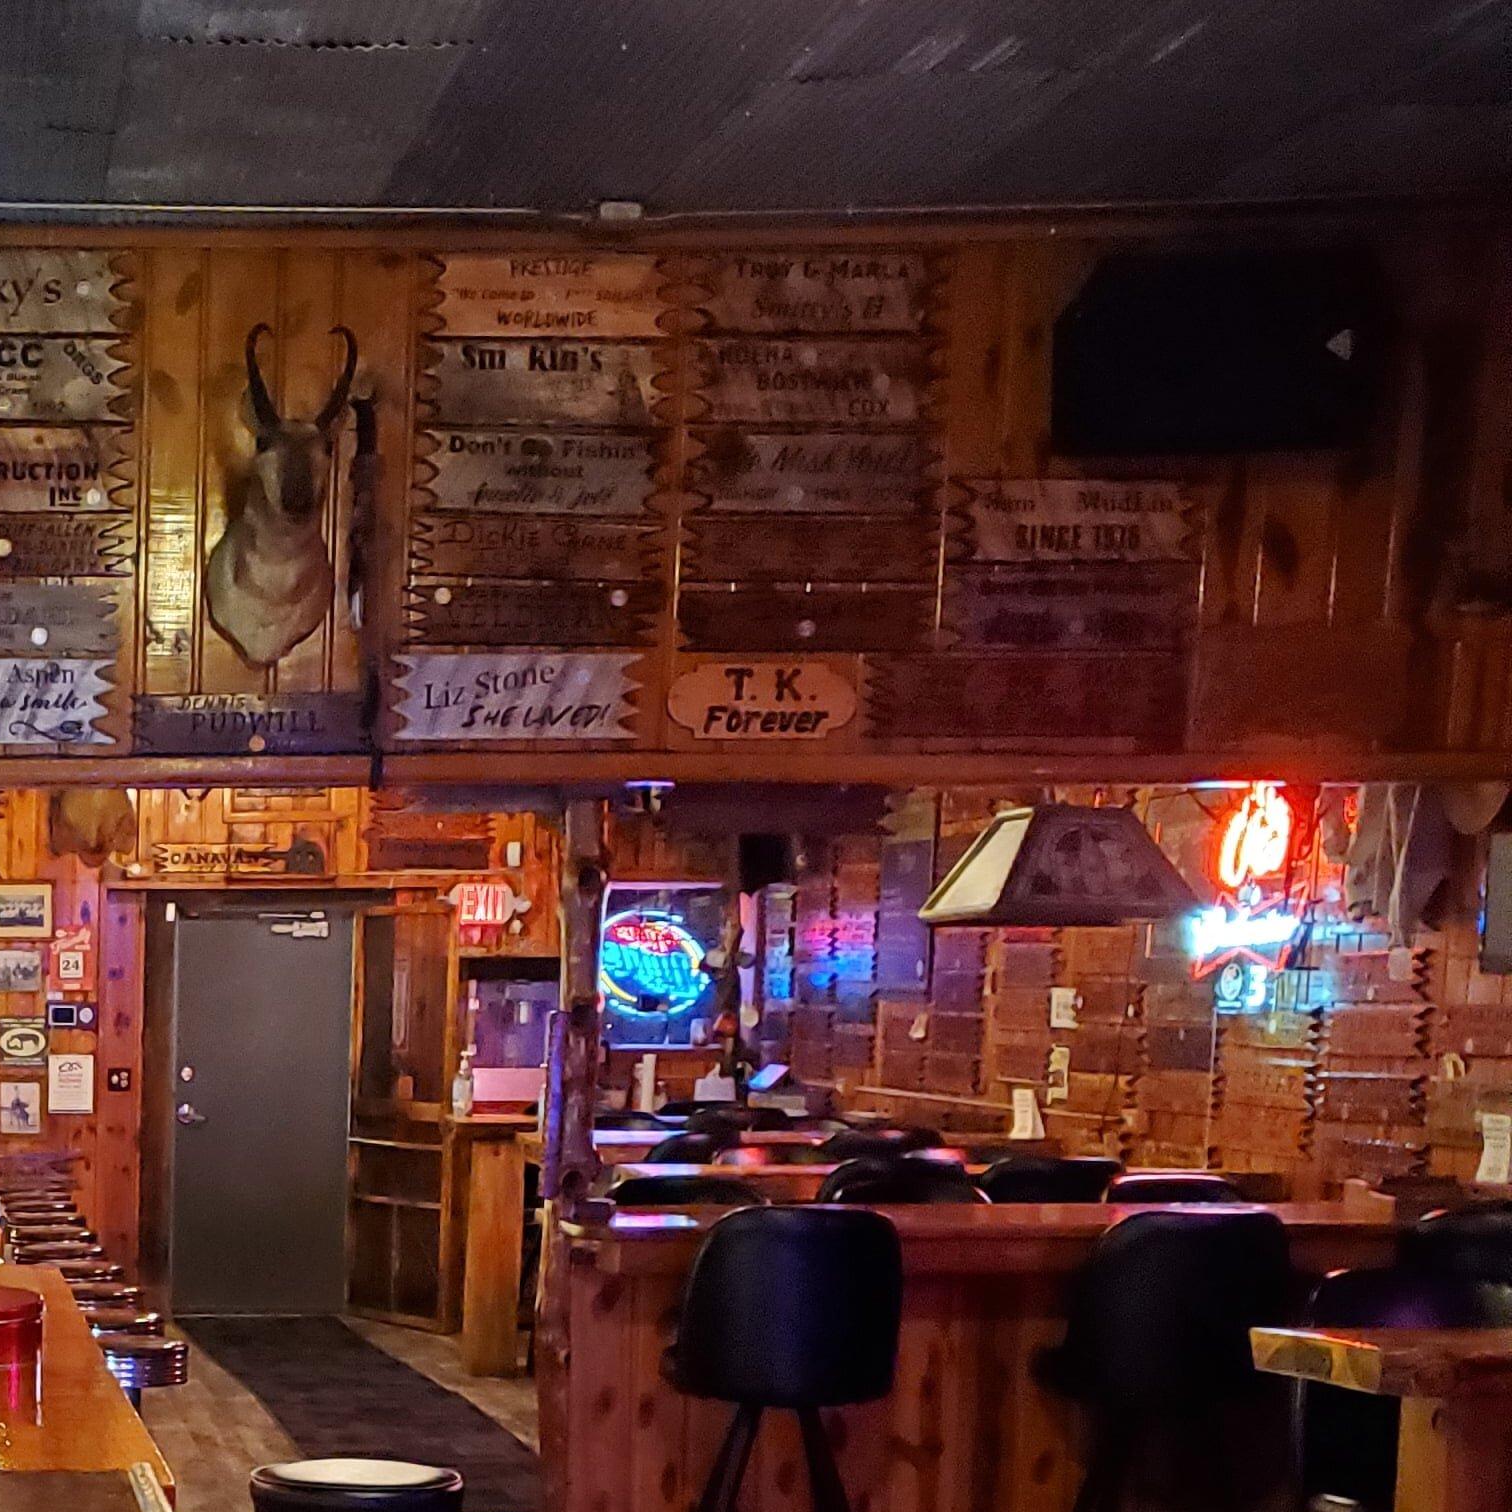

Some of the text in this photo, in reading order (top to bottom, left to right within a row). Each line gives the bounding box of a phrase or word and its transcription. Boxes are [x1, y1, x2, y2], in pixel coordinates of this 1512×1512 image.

[497, 308, 597, 329] WORLDWIDE
[50, 486, 82, 506] INC
[424, 663, 555, 710] Liz Stone
[191, 710, 327, 734] PUDWILL
[461, 704, 518, 728] SHE
[702, 705, 829, 735] Forever
[462, 884, 506, 920] EXIT
[62, 959, 80, 972] 24
